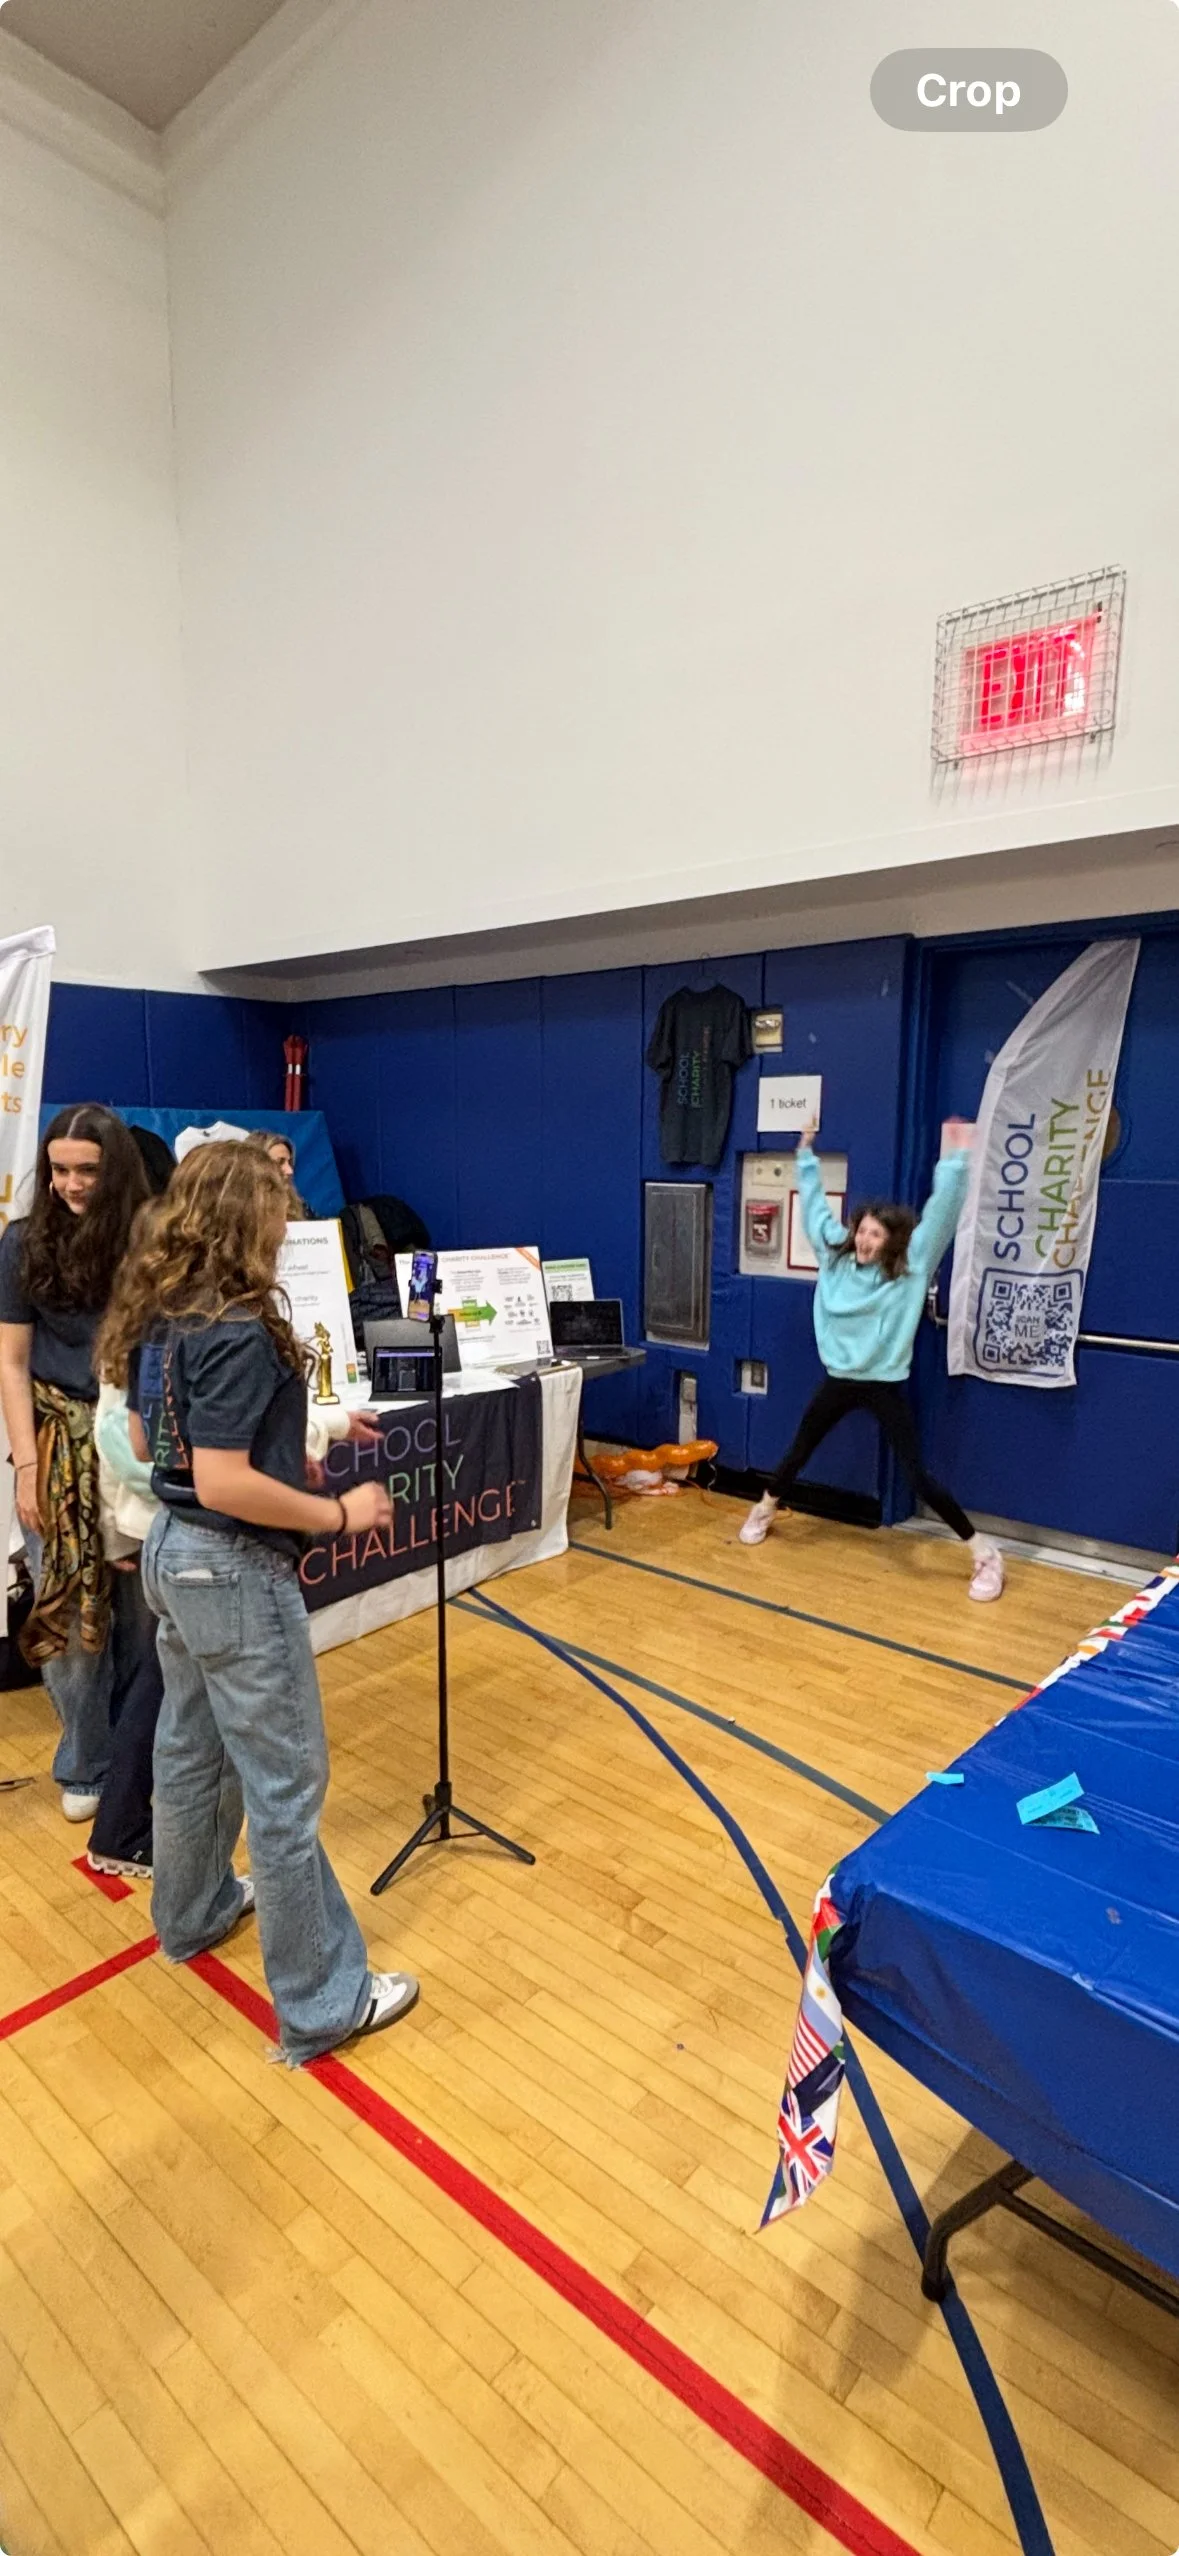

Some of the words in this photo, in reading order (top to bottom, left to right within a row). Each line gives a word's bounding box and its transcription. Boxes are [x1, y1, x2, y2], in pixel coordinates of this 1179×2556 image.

[770, 1098, 775, 1109] 1
[778, 1098, 807, 1109] ticket
[993, 1113, 1036, 1262] SCHOOL
[1034, 1098, 1080, 1259] CHARITY
[1014, 1324, 1041, 1338] ME
[323, 1414, 462, 1478] CHOOL
